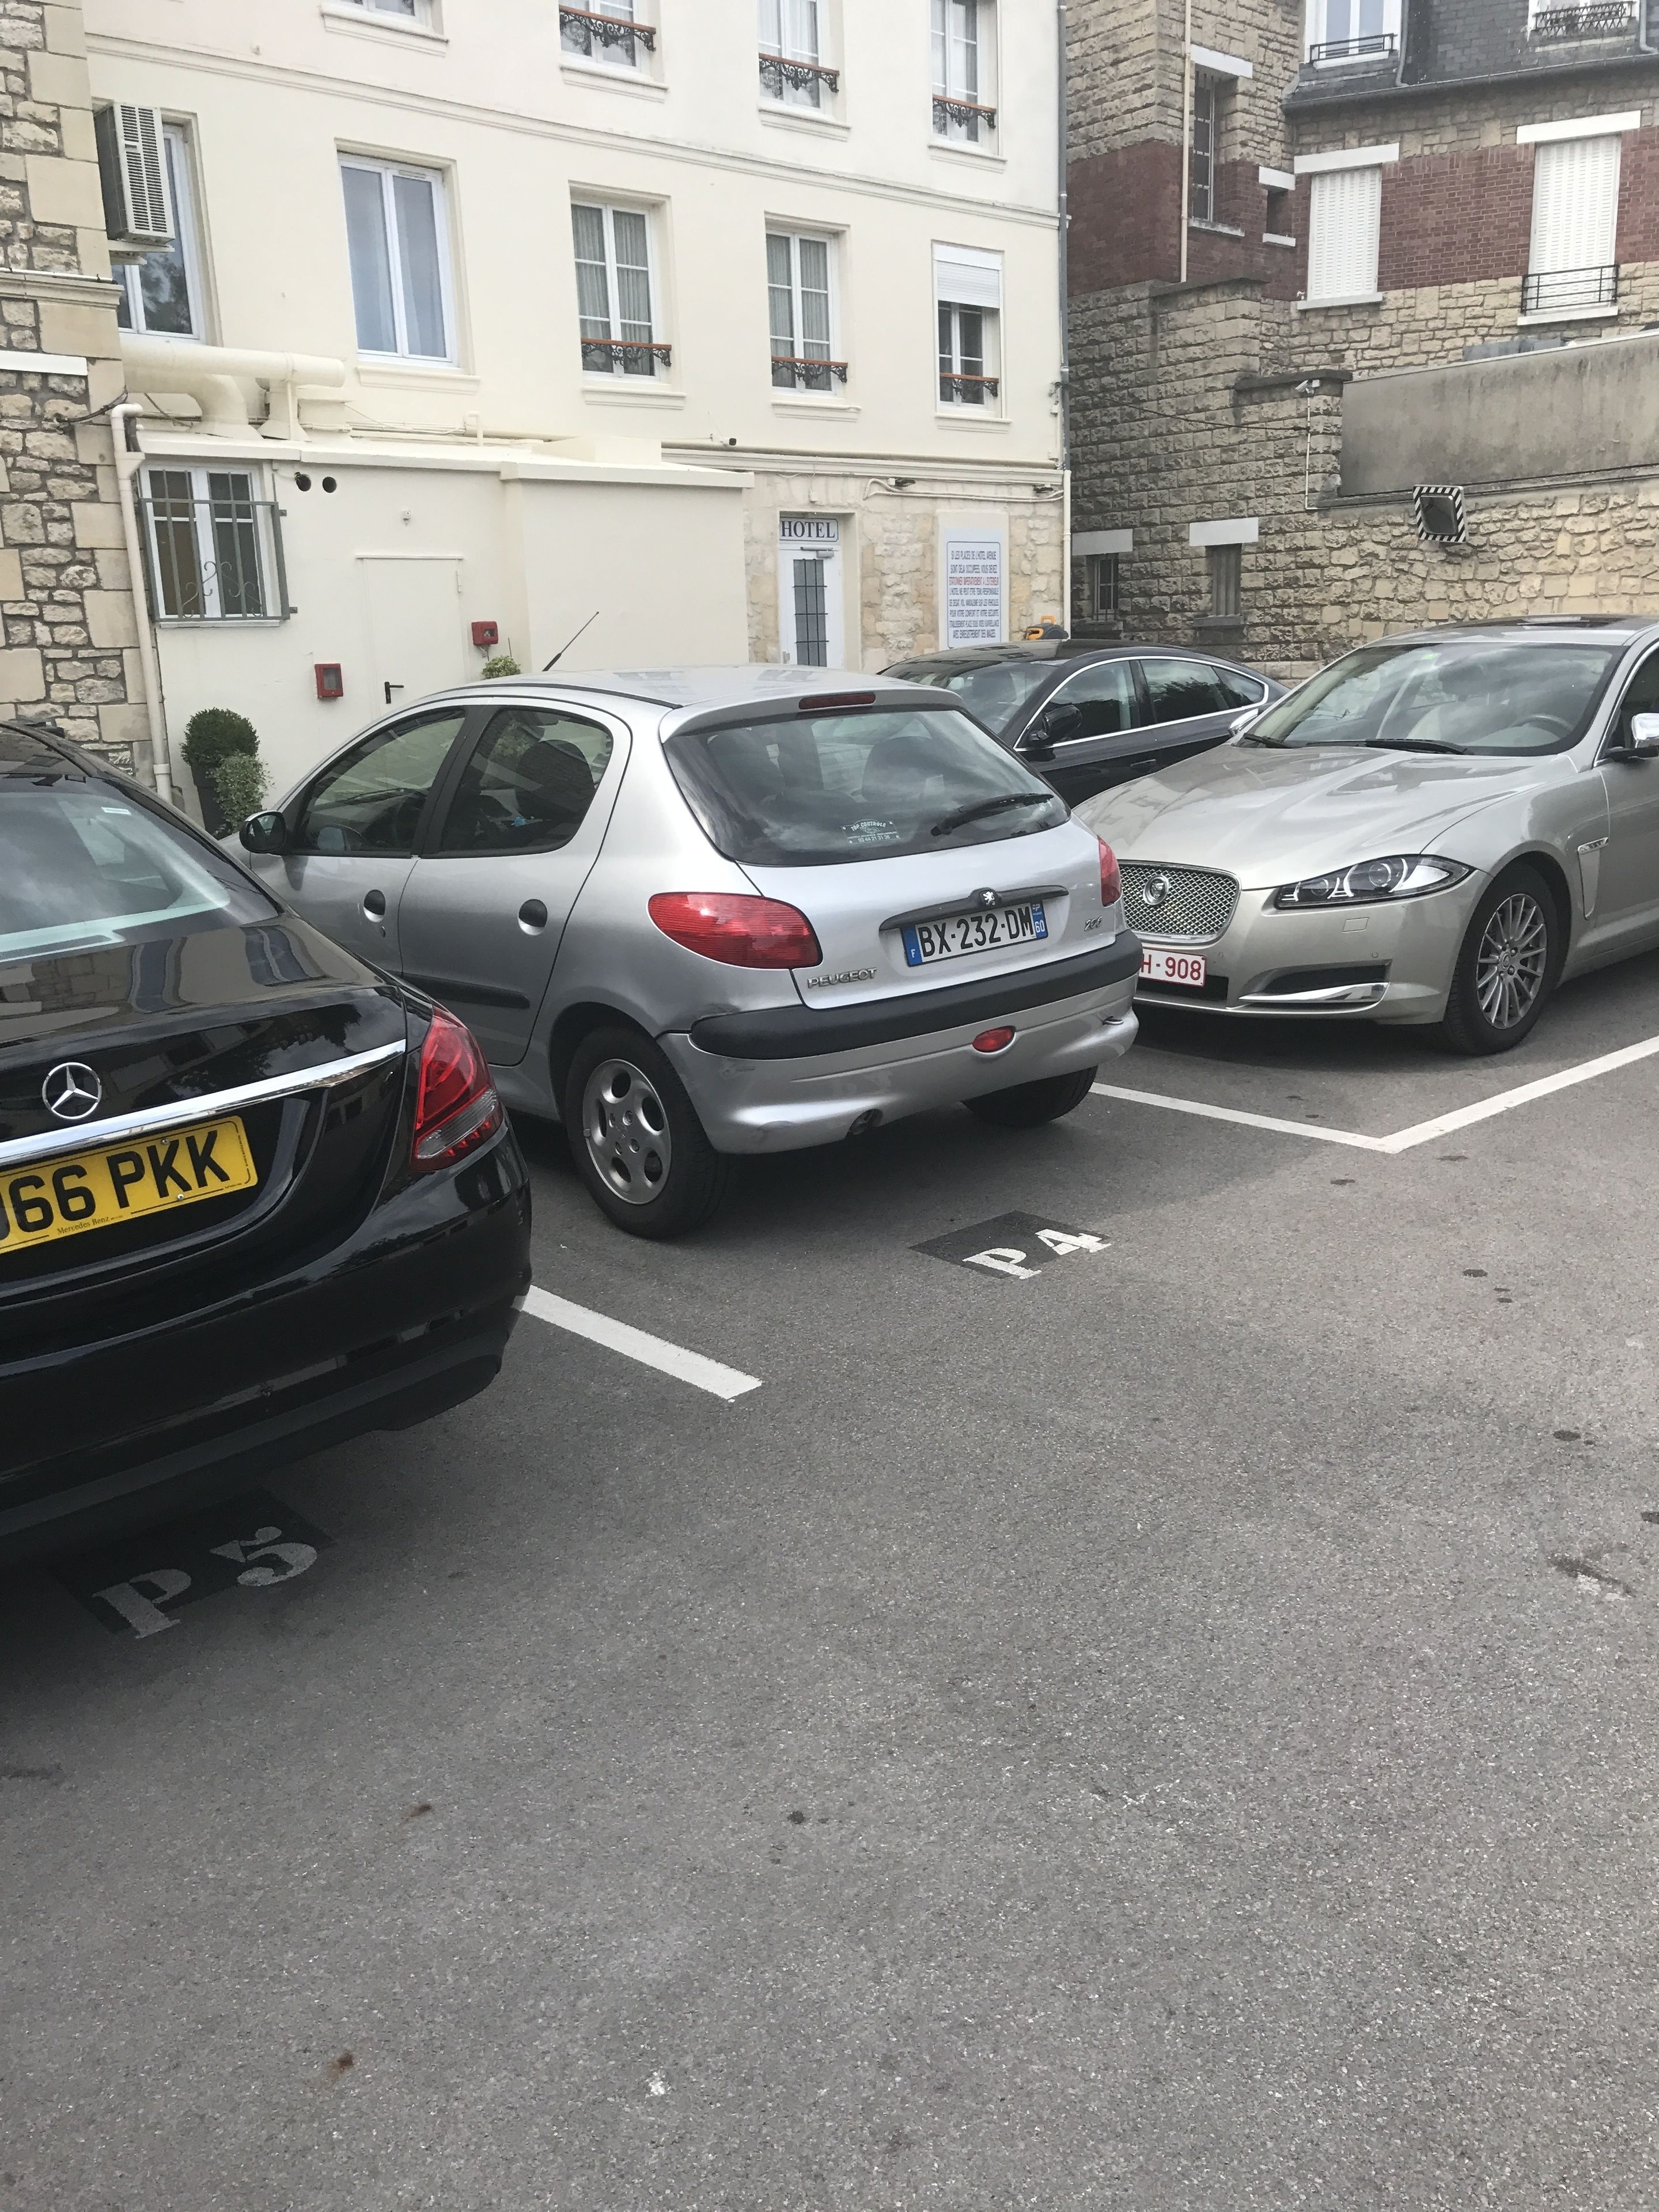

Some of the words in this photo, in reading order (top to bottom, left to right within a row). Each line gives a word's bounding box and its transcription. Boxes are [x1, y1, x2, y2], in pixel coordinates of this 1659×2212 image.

[781, 521, 835, 538] HOTEL
[911, 949, 915, 958] F
[1035, 919, 1046, 933] 60
[808, 967, 877, 988] PEUGEOT
[0, 1164, 96, 1240] 66
[106, 1130, 230, 1209] PKK
[57, 1222, 90, 1234] Mercedes
[92, 1216, 110, 1225] Benz
[961, 1248, 1041, 1279] P
[1035, 1229, 1112, 1256] 4
[92, 1569, 191, 1638] P
[210, 1527, 317, 1586] 5
